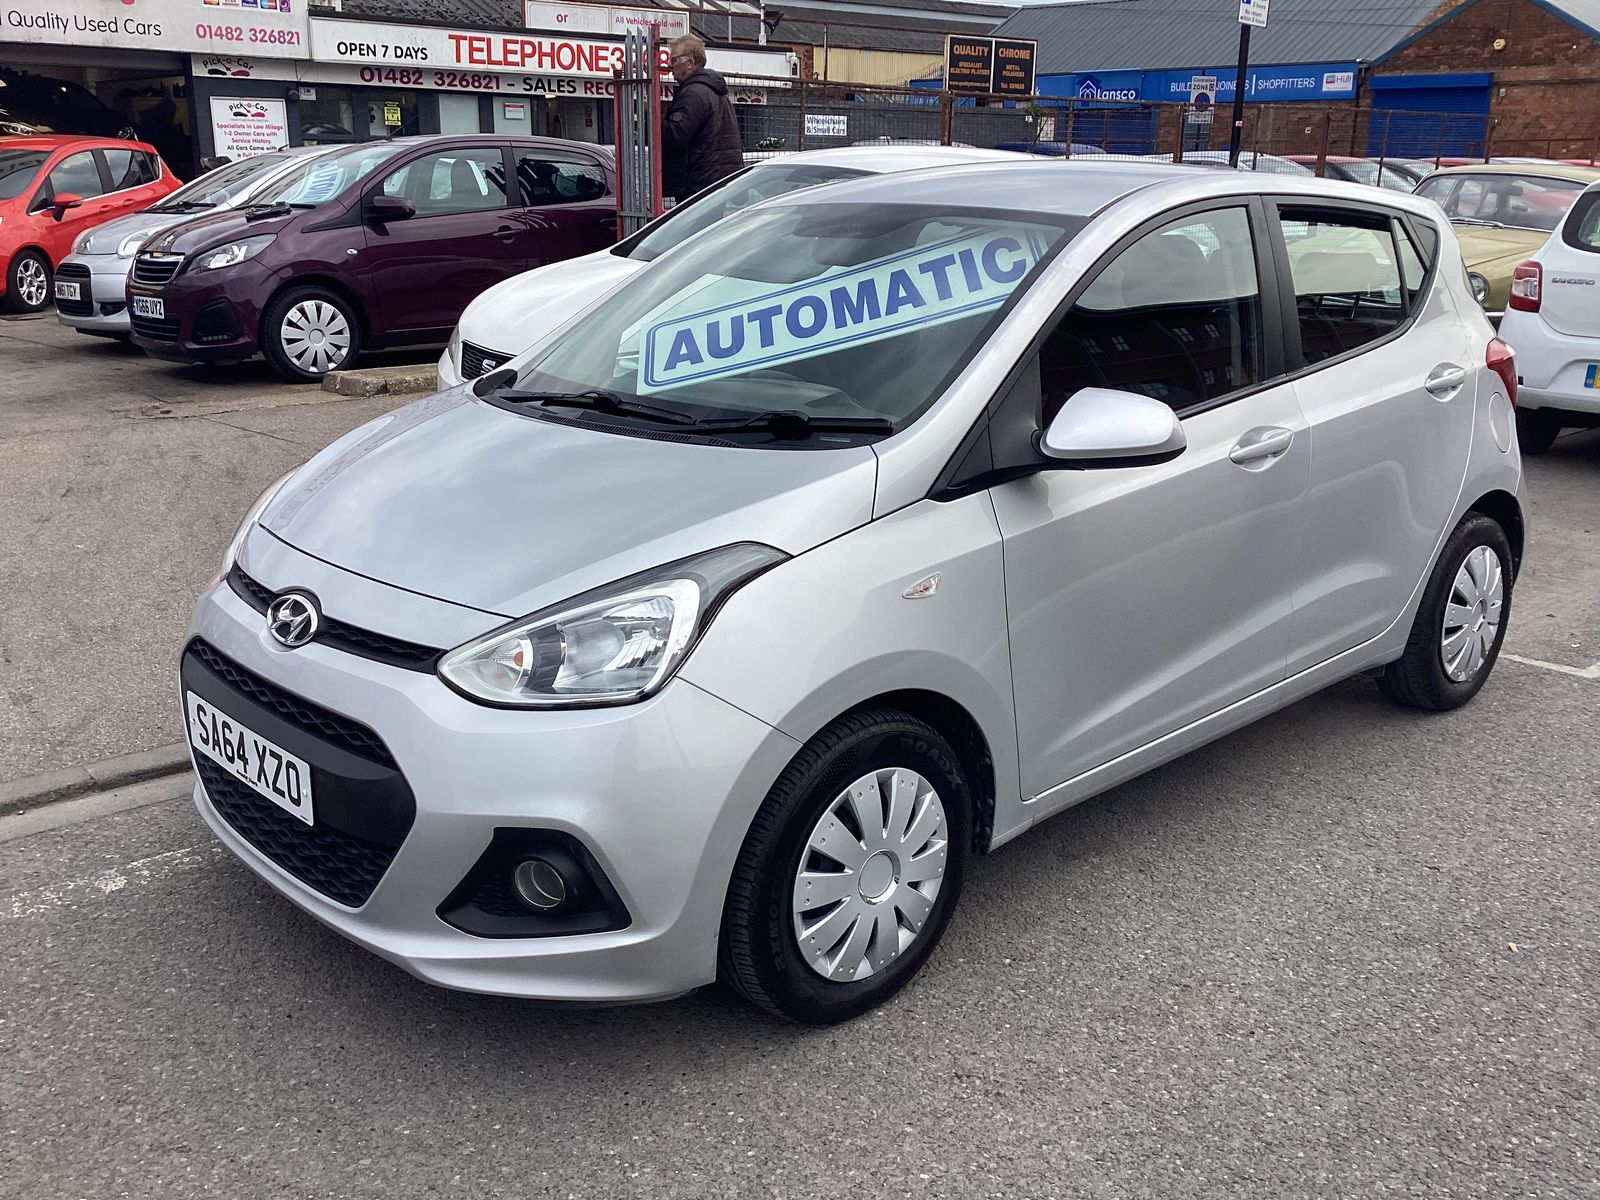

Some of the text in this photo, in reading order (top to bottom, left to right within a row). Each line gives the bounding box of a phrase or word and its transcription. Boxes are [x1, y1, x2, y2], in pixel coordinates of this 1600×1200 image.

[7, 10, 69, 34] Quality
[74, 14, 118, 33] Used
[123, 18, 162, 36] Cars
[556, 13, 569, 23] or
[615, 16, 683, 28] All Vehicles Sold with
[195, 23, 300, 46] 01482 326821
[336, 41, 428, 61] OPEN 7 DAYS
[953, 44, 1031, 60] QUALITY CHROME
[202, 56, 254, 71] Pick-a-Car
[359, 66, 424, 86] 01482
[433, 71, 501, 90] 326821
[522, 77, 577, 95] SALES
[1216, 80, 1250, 91] JOINES
[1257, 77, 1316, 90] SHOPFITTERS
[1097, 88, 1136, 100] Lansco
[228, 101, 269, 113] Pick-a-Car
[806, 116, 846, 125] Wheelchairs
[806, 126, 812, 134] &
[832, 127, 845, 135] Cars
[1551, 277, 1596, 286] SANDERO
[663, 236, 1027, 371] AUTOMATIC
[196, 703, 302, 808] SA64 XZO
